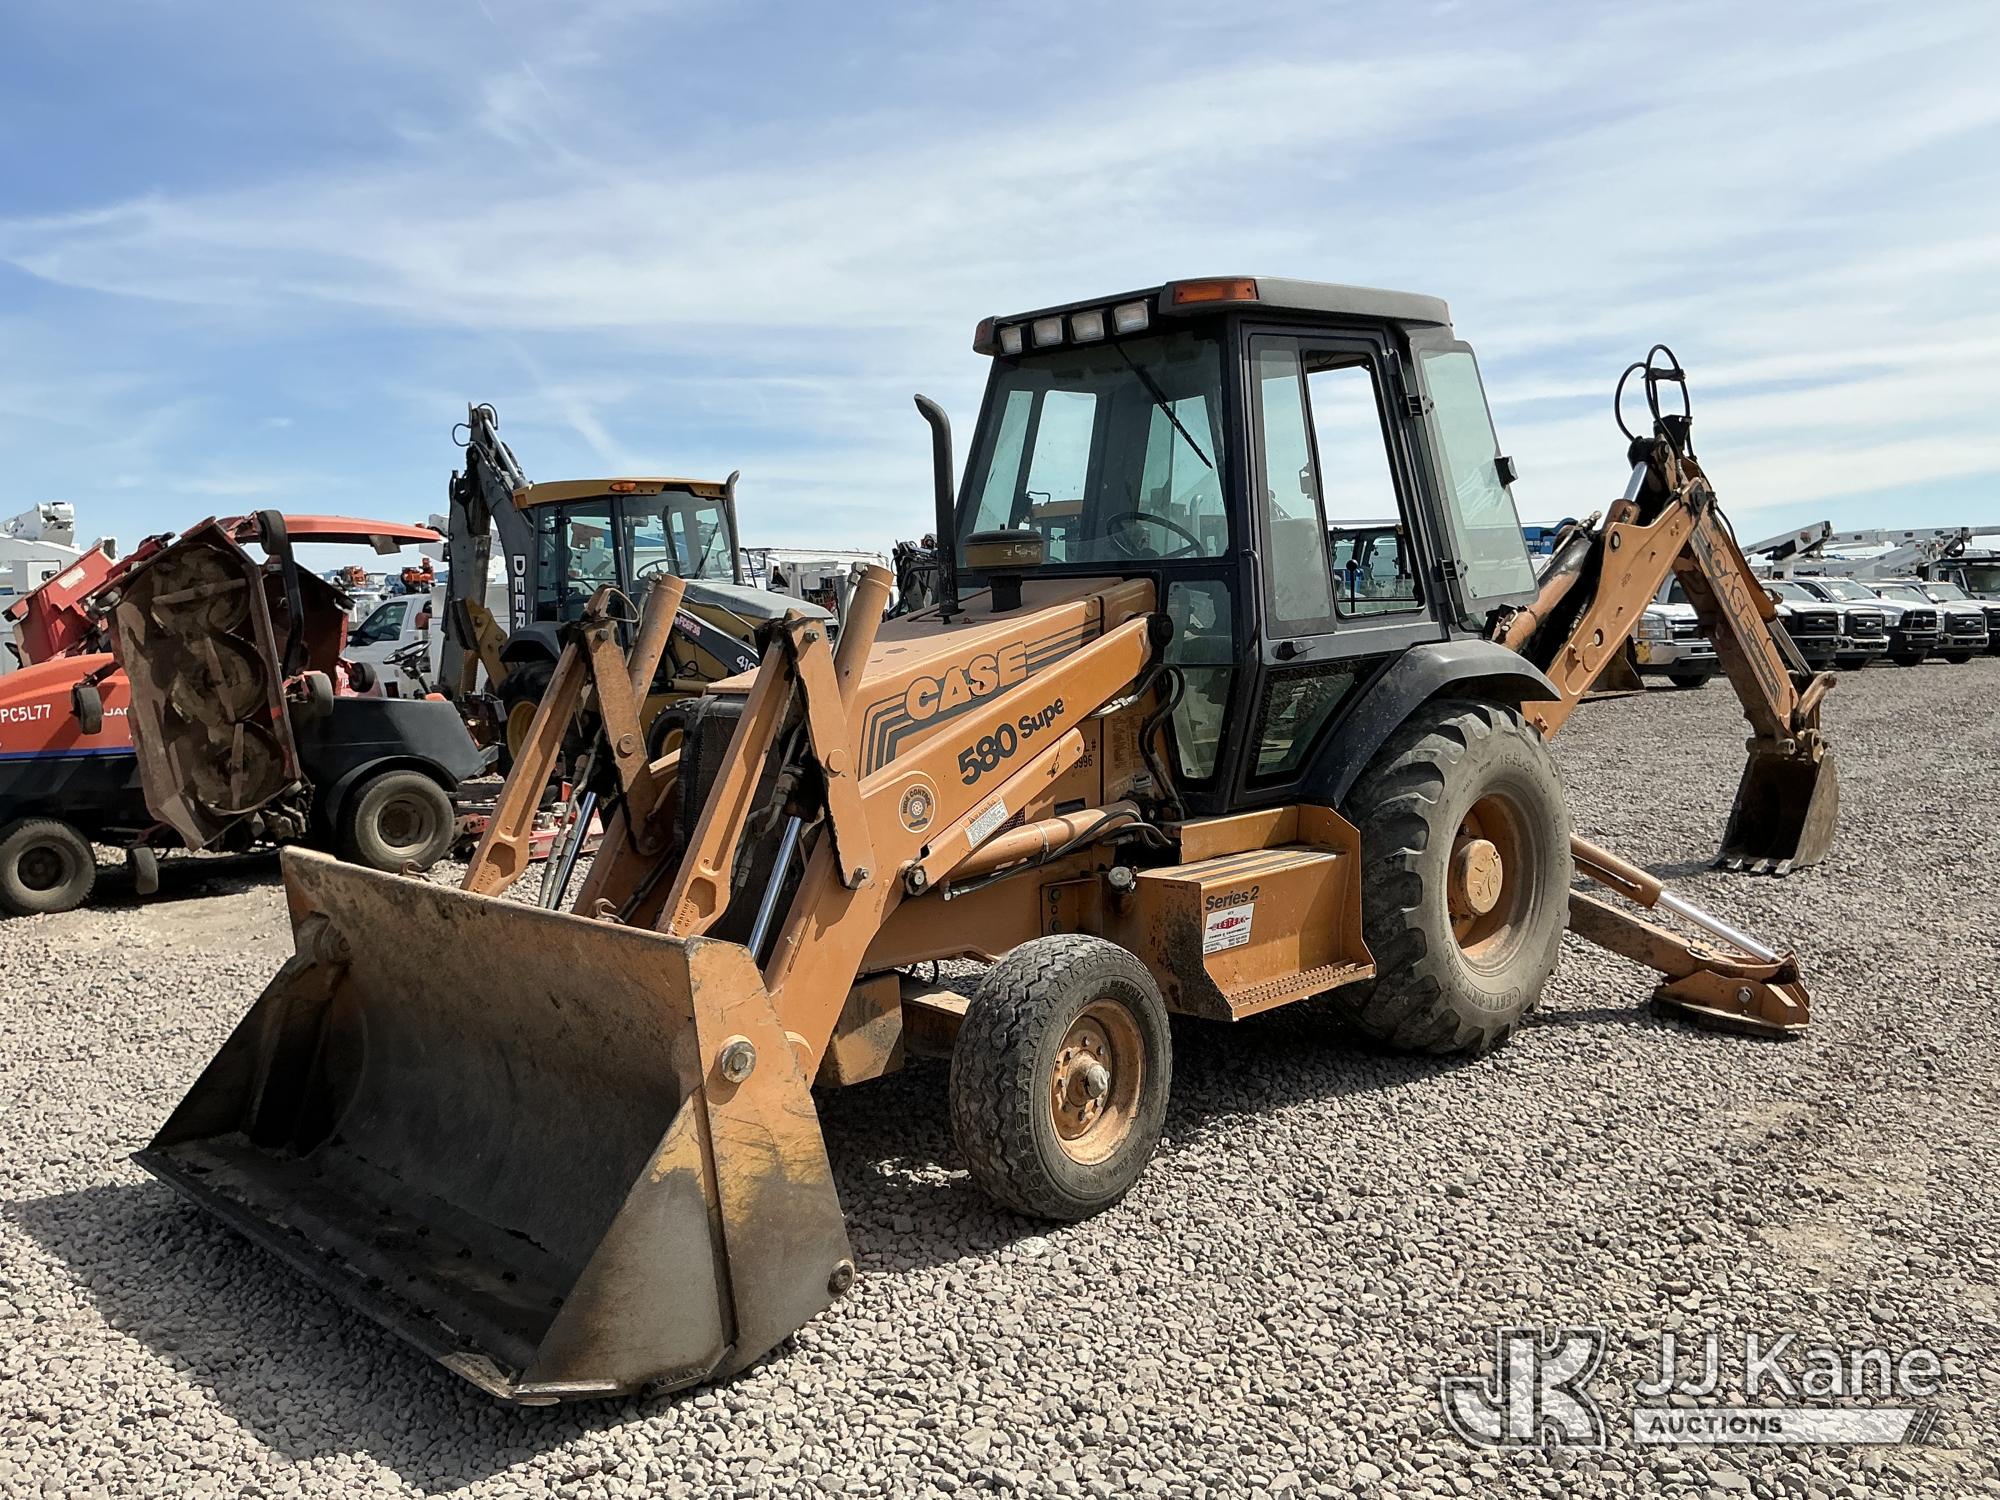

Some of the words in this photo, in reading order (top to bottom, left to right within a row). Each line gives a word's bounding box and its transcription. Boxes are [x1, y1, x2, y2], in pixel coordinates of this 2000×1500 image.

[512, 554, 527, 629] DEER
[1711, 549, 1756, 635] CASE
[0, 704, 51, 723] PC5L77
[905, 640, 1028, 721] CASE
[957, 722, 1018, 785] 580
[1018, 698, 1064, 739] Supe
[909, 788, 932, 808] CONTROL
[1205, 890, 1249, 911] Series
[1249, 885, 1260, 901] 2
